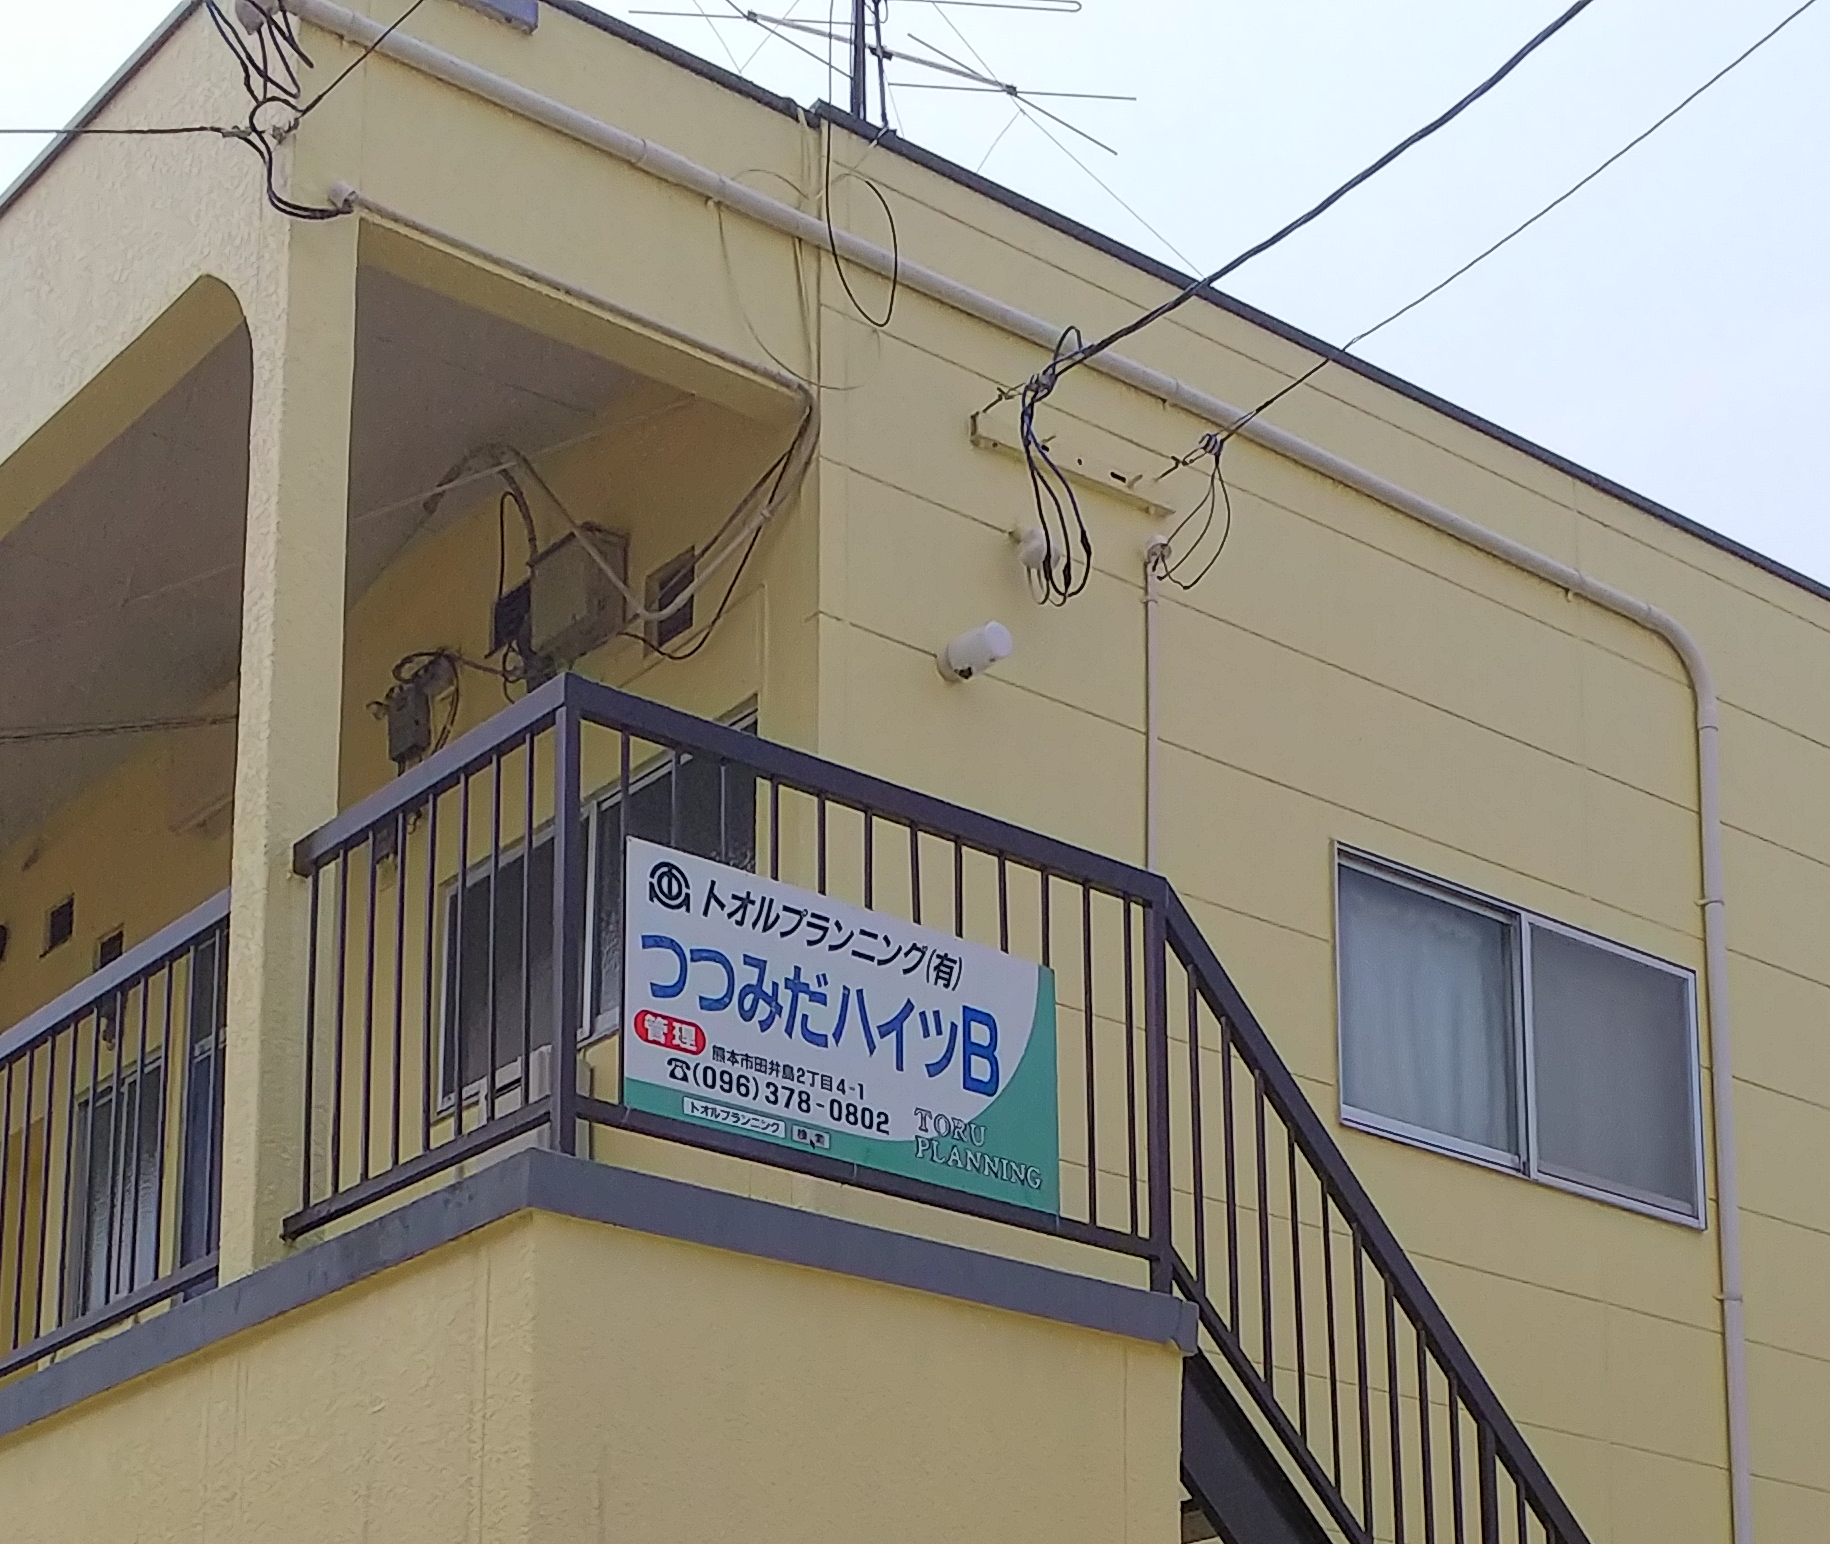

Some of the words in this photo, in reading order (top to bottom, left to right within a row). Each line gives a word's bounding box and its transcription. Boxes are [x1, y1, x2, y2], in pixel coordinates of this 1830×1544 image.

[702, 880, 963, 992] トオルプランニング(有)
[640, 934, 1000, 1098] つつみだハイツB
[643, 1013, 698, 1052] 管理
[692, 1062, 890, 1136] (096)378-0802
[913, 1107, 987, 1147] TORU
[914, 1135, 1044, 1191] PLANNING
